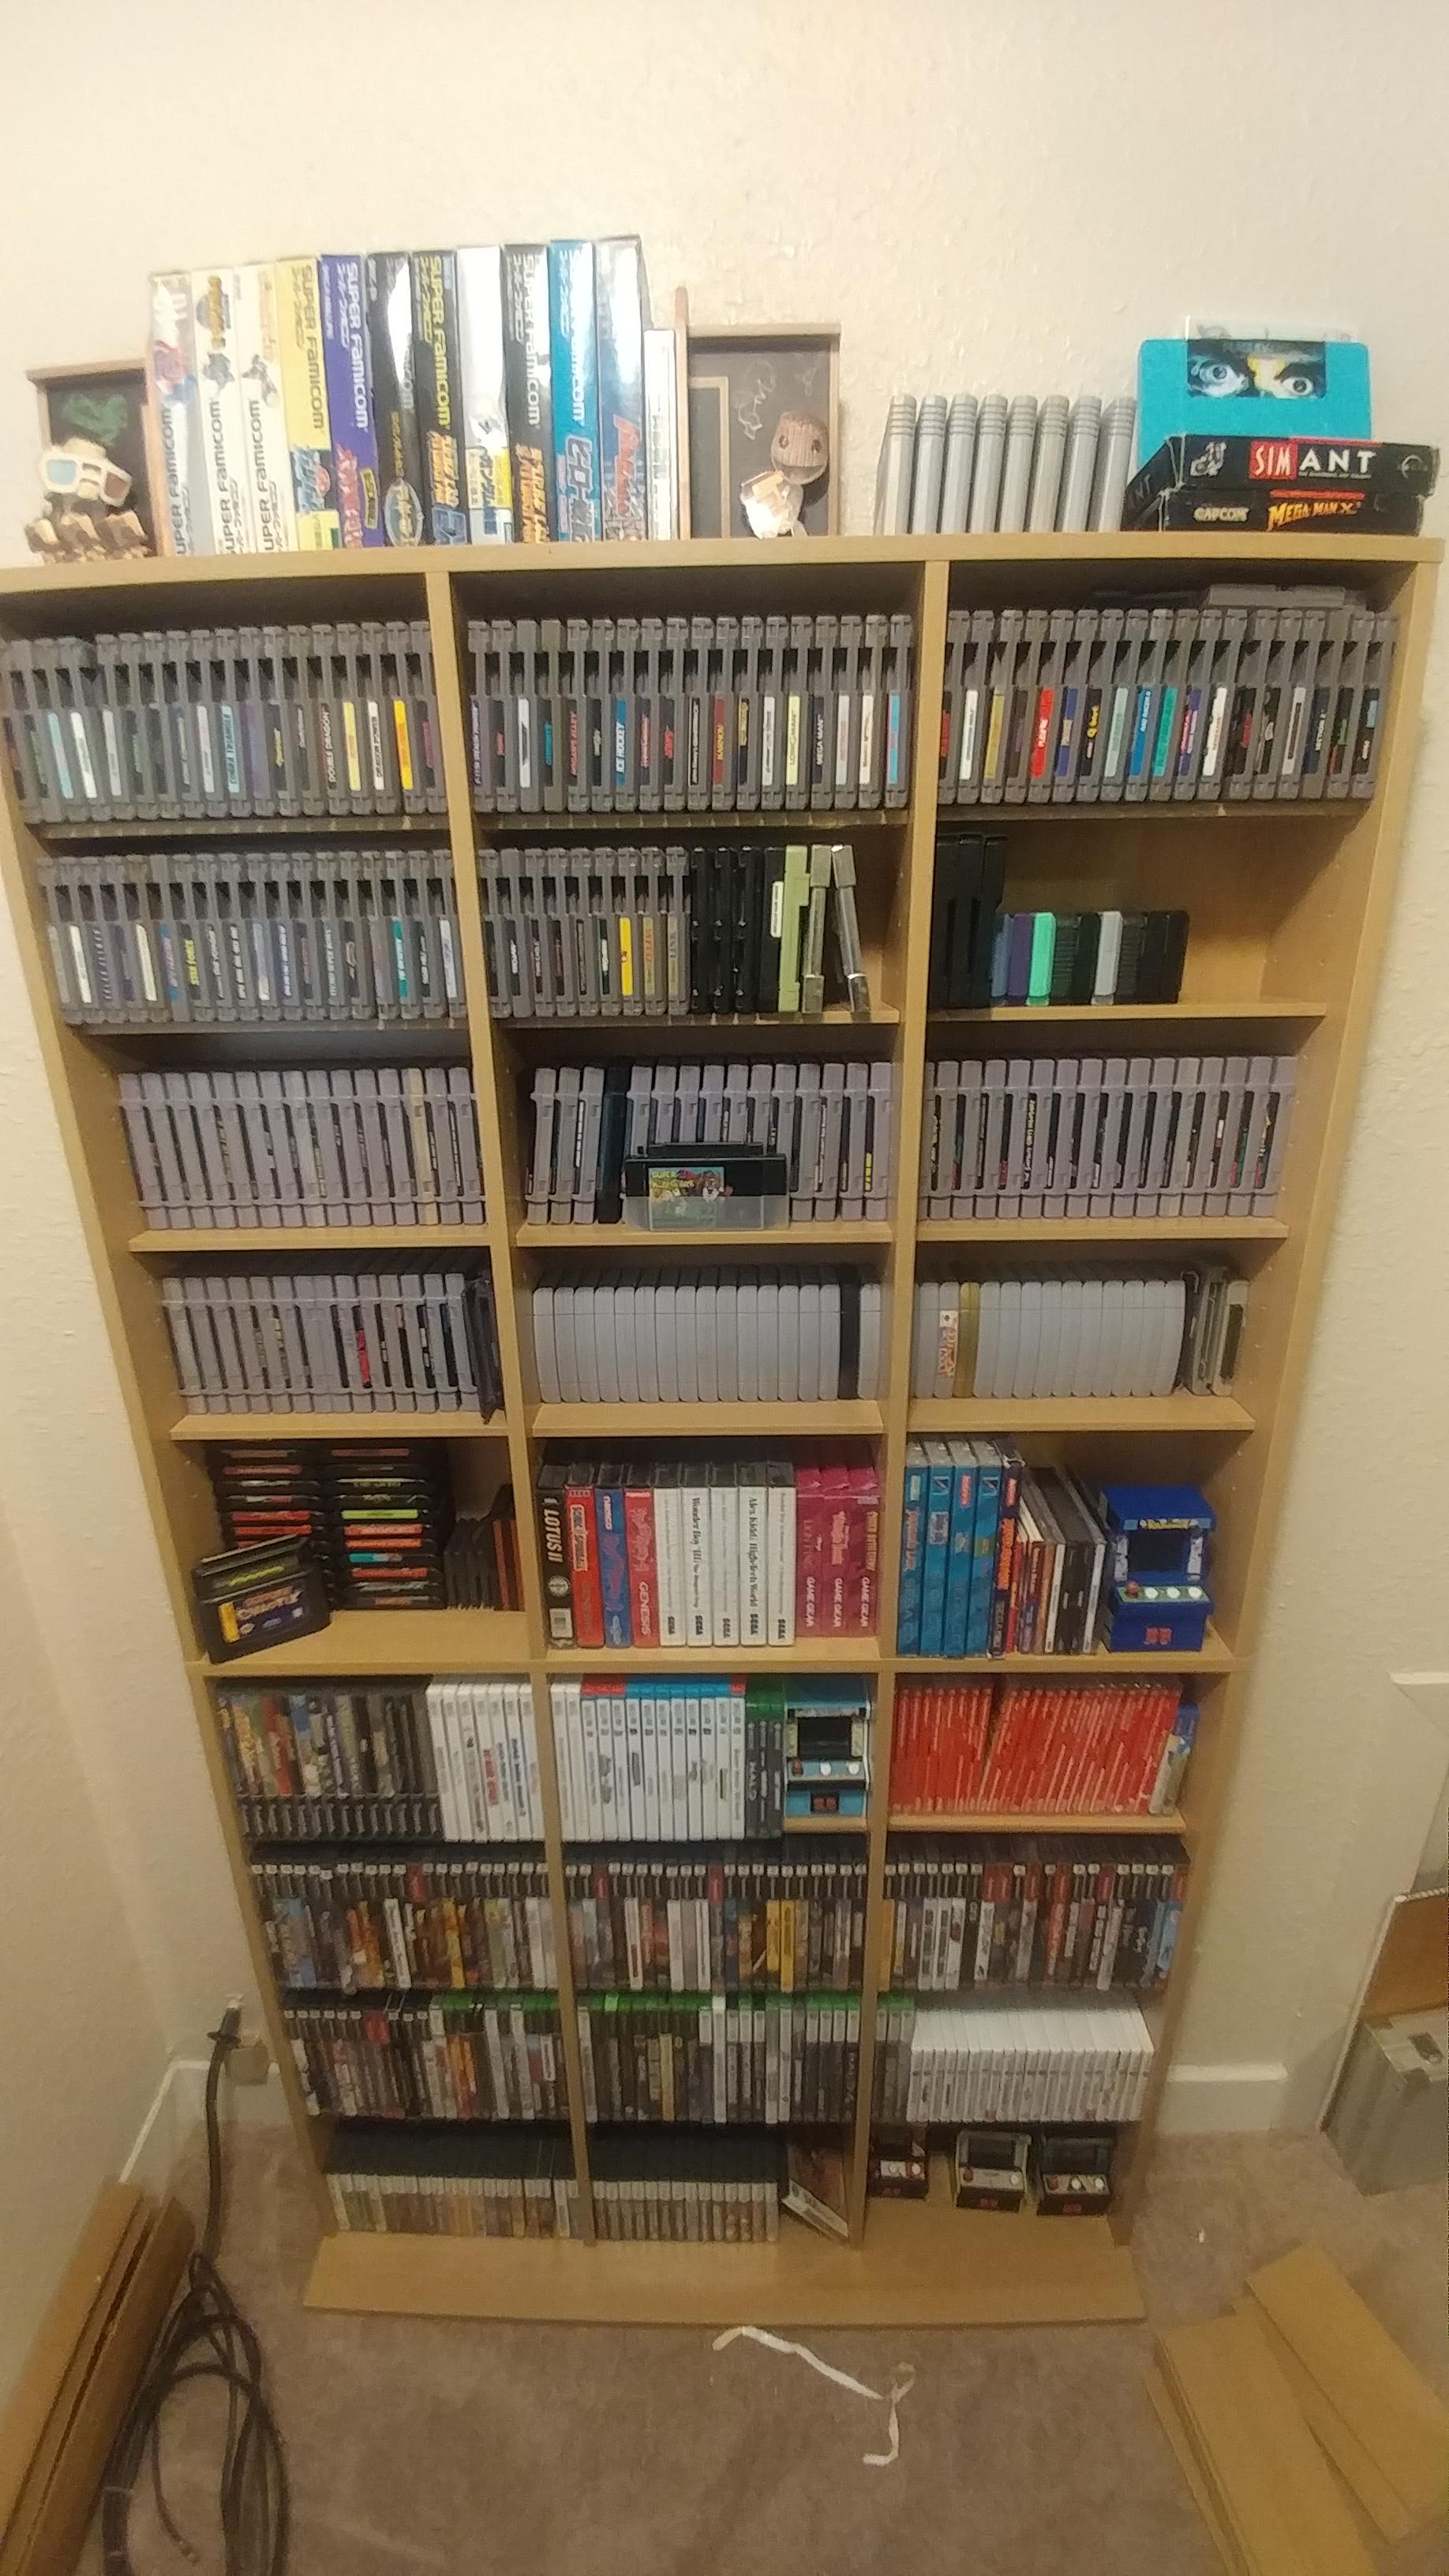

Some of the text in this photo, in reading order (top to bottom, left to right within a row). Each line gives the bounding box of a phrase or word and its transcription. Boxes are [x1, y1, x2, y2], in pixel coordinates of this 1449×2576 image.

[347, 262, 361, 329] SUPER
[430, 256, 444, 324] SUPER
[1299, 447, 1376, 473] ANT
[171, 503, 188, 554] UPER
[219, 498, 236, 553] UPER
[258, 498, 276, 551] UPER
[1193, 506, 1249, 522] CAPCOM
[1267, 502, 1357, 530] MEGA MAN X
[321, 710, 336, 783] DOUBLE DRAGON
[616, 721, 626, 773] ICE HOCKEY
[815, 740, 824, 766] MEGA
[543, 1507, 563, 1553] LOTUS
[638, 1581, 651, 1636] GENESIS
[805, 1576, 816, 1627] GAME GEAR
[833, 1577, 844, 1627] GAME GEAR
[860, 1576, 871, 1627] GAME GEAR
